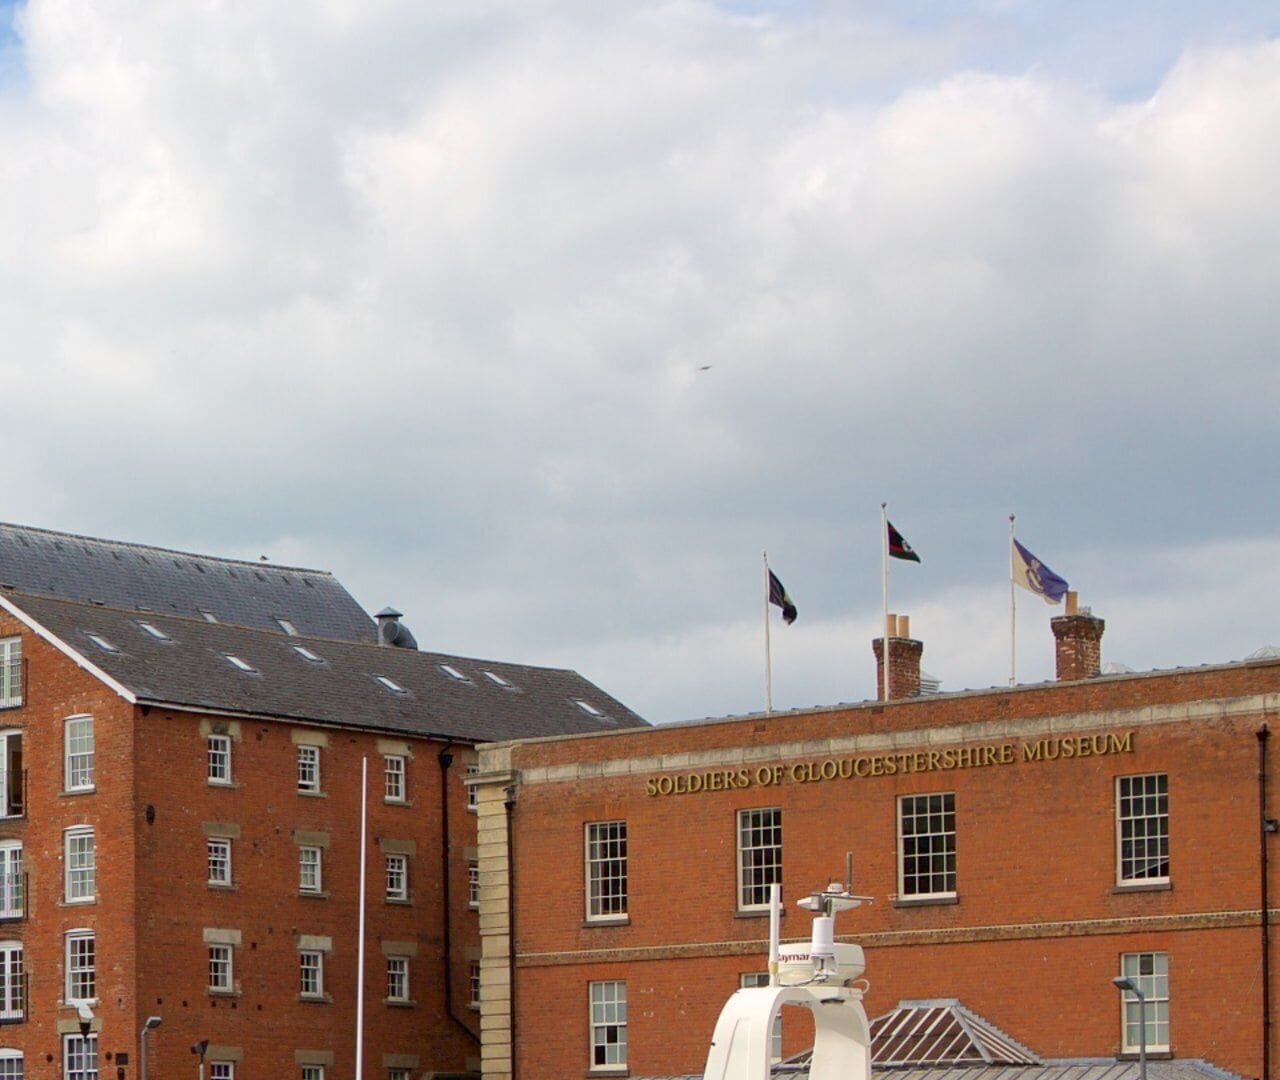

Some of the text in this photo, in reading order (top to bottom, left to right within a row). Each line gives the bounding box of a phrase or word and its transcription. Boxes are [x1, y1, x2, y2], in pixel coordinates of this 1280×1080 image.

[645, 731, 1135, 797] SOLDIERS OF GLOUCESTERSHIRE MUSEUM
